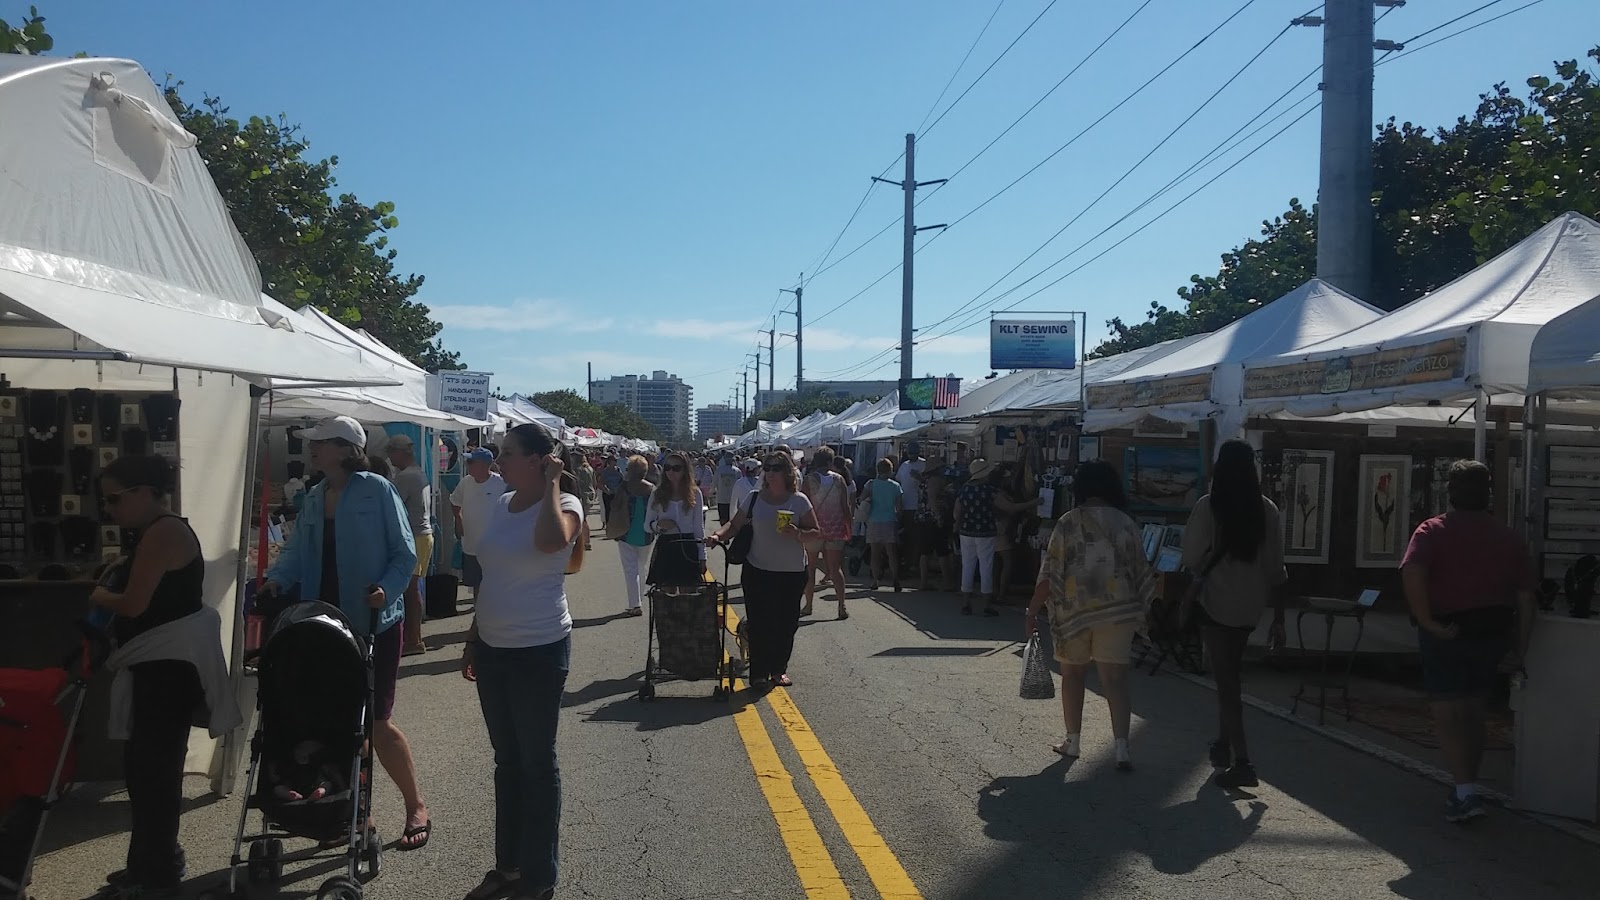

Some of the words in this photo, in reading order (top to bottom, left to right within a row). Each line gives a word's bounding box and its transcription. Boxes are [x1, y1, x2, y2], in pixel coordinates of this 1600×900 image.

[1000, 324, 1019, 334] KLT
[1023, 324, 1068, 334] SEWING
[1249, 373, 1290, 390] GLASS
[1292, 369, 1321, 387] ART
[1369, 361, 1395, 378] Tess
